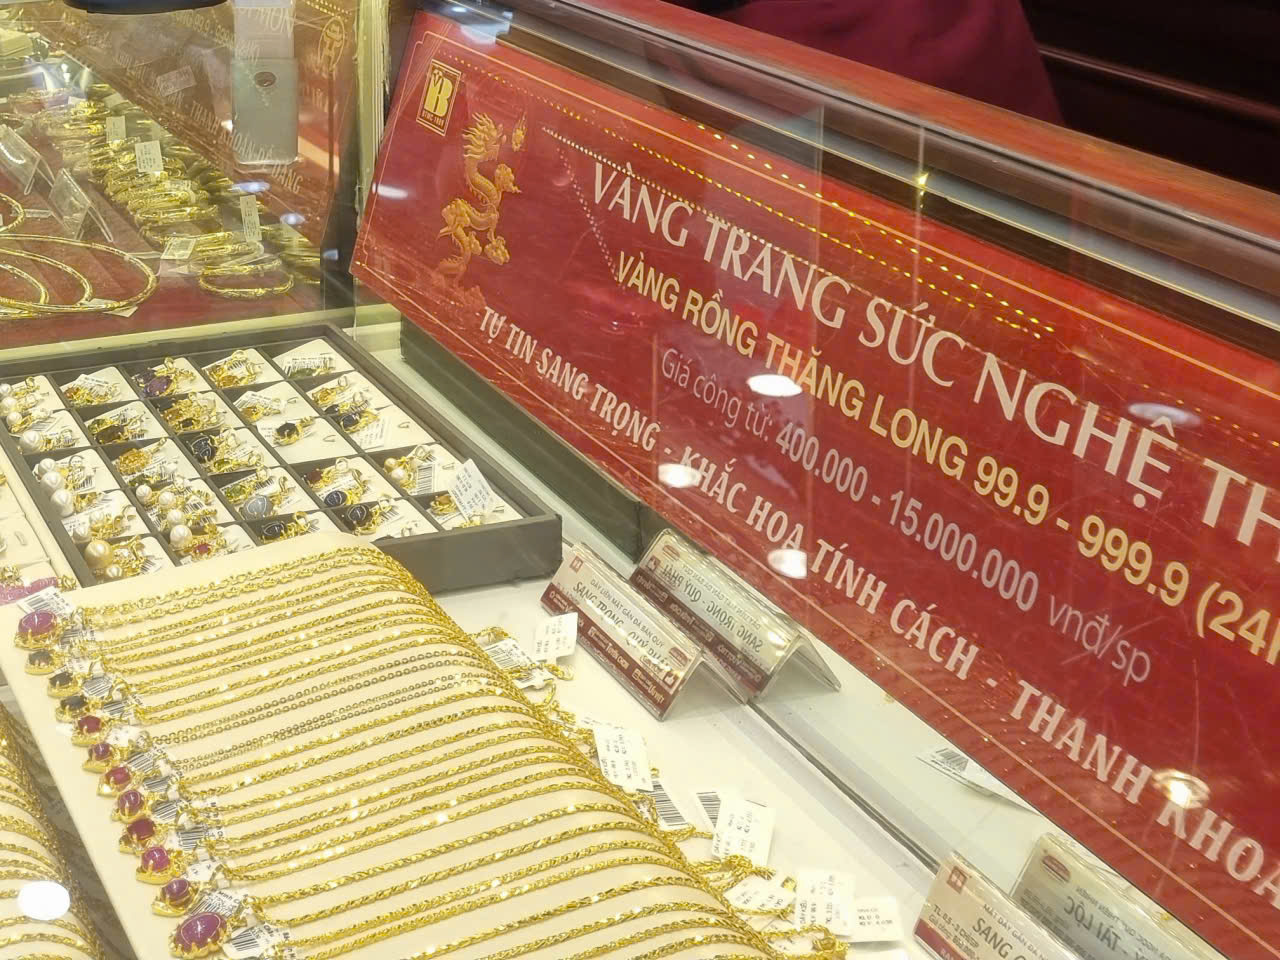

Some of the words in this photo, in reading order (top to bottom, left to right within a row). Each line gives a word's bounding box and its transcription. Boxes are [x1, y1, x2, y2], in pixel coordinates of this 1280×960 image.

[593, 161, 693, 248] VÀNG
[703, 215, 852, 329] TRANG
[858, 297, 967, 388] SỨC
[973, 351, 1179, 510] NGHỆ
[617, 250, 681, 313] VÀNG
[682, 288, 759, 359] RỒNG
[764, 332, 866, 421] THĂNG
[869, 394, 968, 481] LONG
[973, 455, 1050, 526] 99.9
[1076, 513, 1190, 608] 999.9
[505, 322, 538, 365] TIN
[535, 347, 589, 401] SANG
[589, 383, 661, 452] TRỌNG
[808, 537, 888, 615] TÍNH
[889, 598, 980, 681] CÁCH
[1009, 679, 1154, 805] THANH
[661, 347, 692, 389] Giá
[692, 373, 742, 428] công
[744, 401, 773, 442] từ:
[775, 420, 868, 503] 400.000
[888, 489, 1040, 612] 15.000.000
[1049, 593, 1152, 687] vnđ/sp
[971, 917, 1014, 959] SANG
